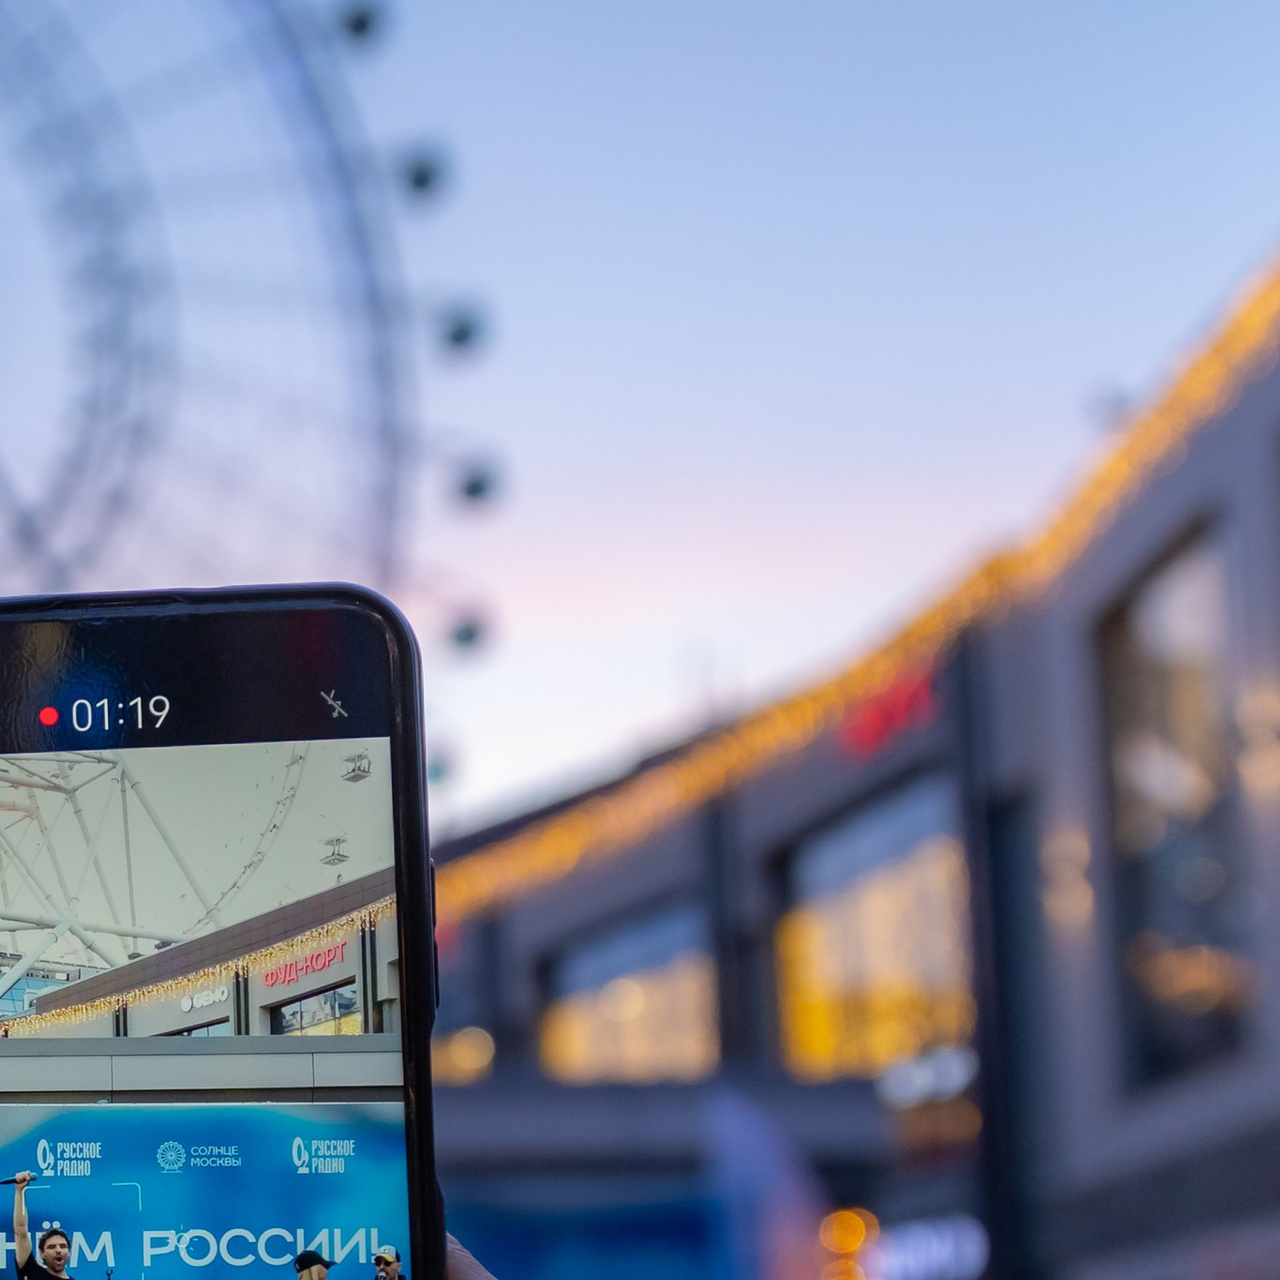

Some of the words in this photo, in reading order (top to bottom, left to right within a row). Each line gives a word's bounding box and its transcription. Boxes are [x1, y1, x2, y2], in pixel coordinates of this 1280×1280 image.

[72, 695, 170, 732] 01:19
[263, 941, 347, 988] ФУД-КОРТ
[57, 1142, 102, 1159] РУССКОЕ
[190, 1146, 239, 1158] СОЛНЦЕ
[312, 1139, 355, 1156] РУССКОЕ
[57, 1160, 91, 1176] РАДИО
[190, 1157, 242, 1168] МОСКВЫ
[312, 1158, 345, 1174] РАДИО
